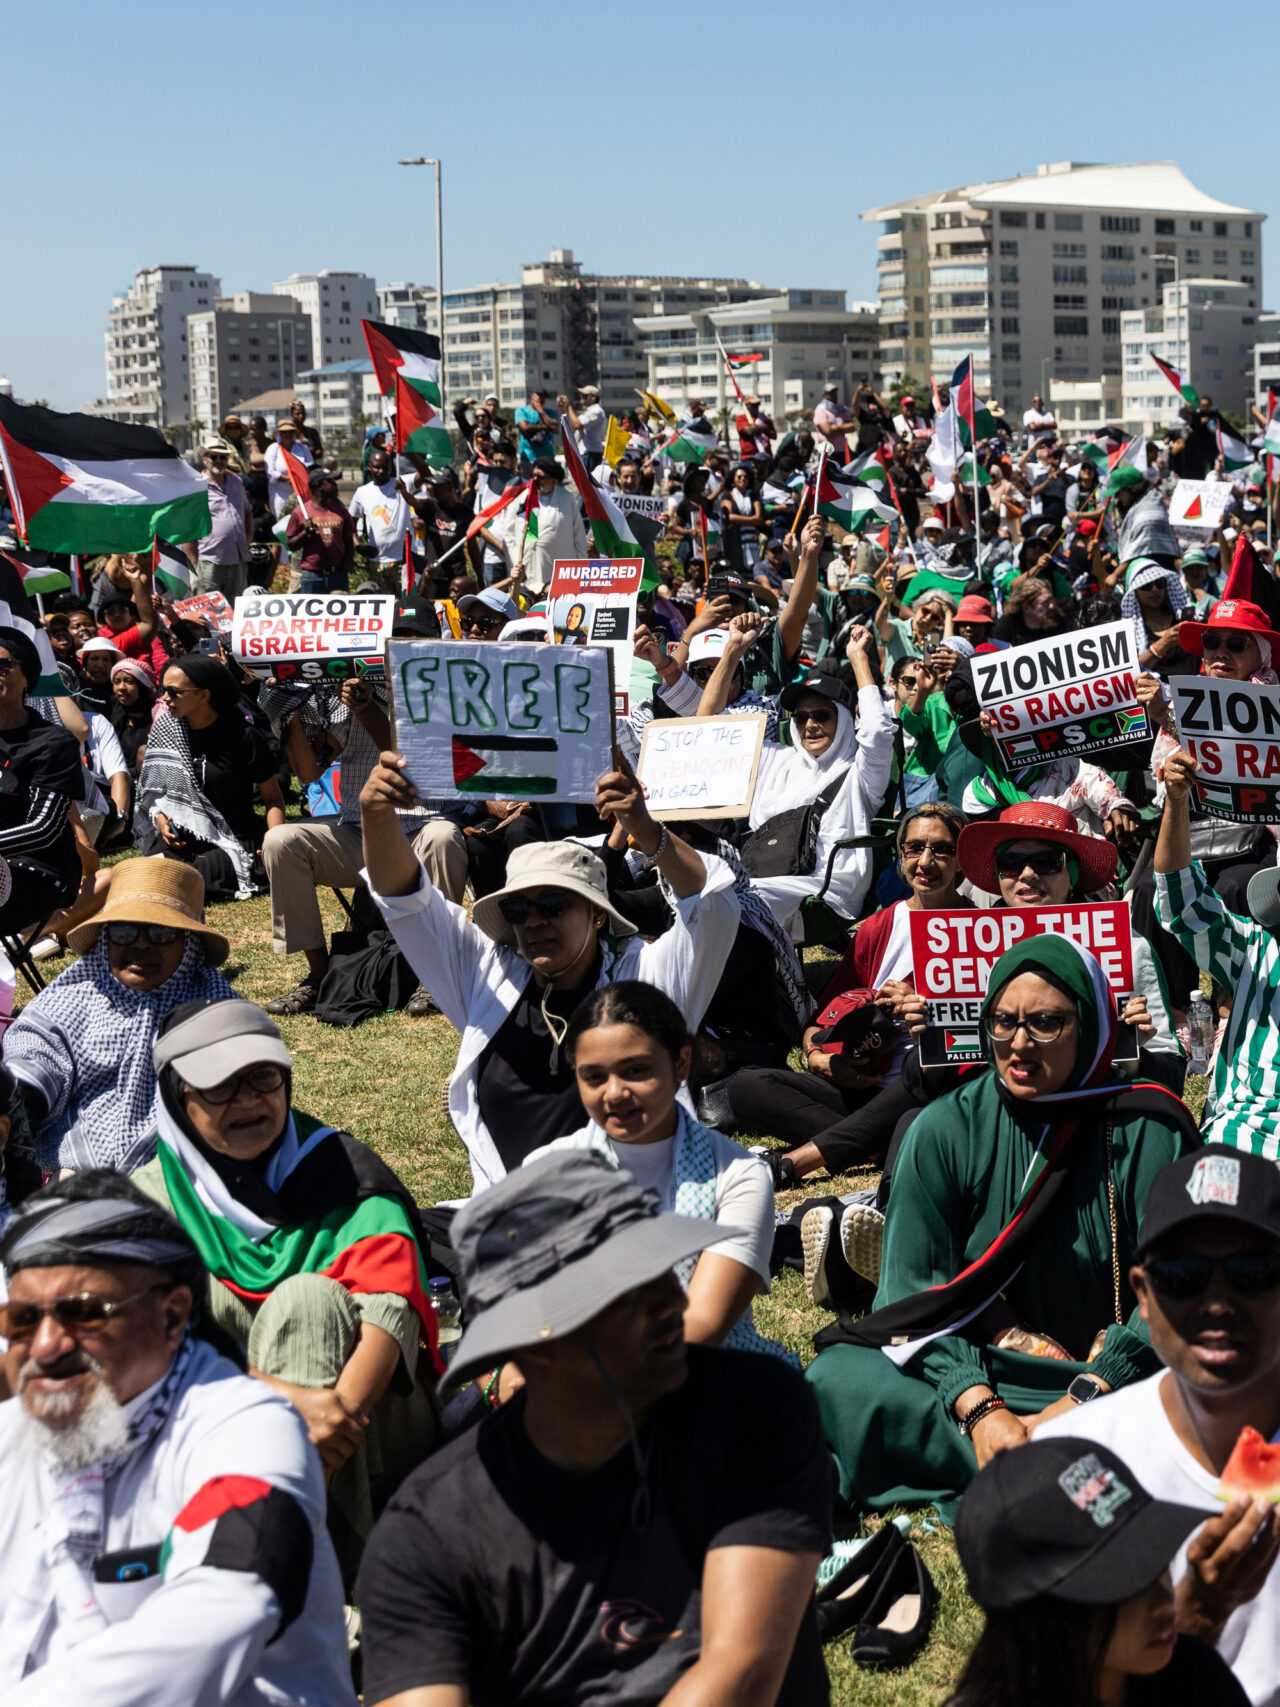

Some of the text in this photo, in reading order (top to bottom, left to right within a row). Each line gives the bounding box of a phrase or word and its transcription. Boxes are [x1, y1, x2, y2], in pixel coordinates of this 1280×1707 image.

[611, 496, 664, 512] ZIONISM
[558, 565, 637, 580] MURDERED
[243, 598, 386, 618] BOYCOTT
[240, 618, 383, 637] APARTHEID
[240, 634, 329, 657] ISRAEL
[977, 630, 1130, 702] ZIONISM
[401, 656, 592, 734] FREE
[989, 672, 1137, 733] IS RACISM
[656, 727, 744, 752] STOP THE
[1012, 730, 1147, 767] PALESTINE SOLIDARITY CAMPAIGN
[652, 753, 752, 780] GENOCIDE
[1187, 739, 1223, 776] IS
[669, 784, 708, 797] GAZA
[1201, 805, 1256, 823] PALESTINE
[926, 910, 1117, 954] STOP THE
